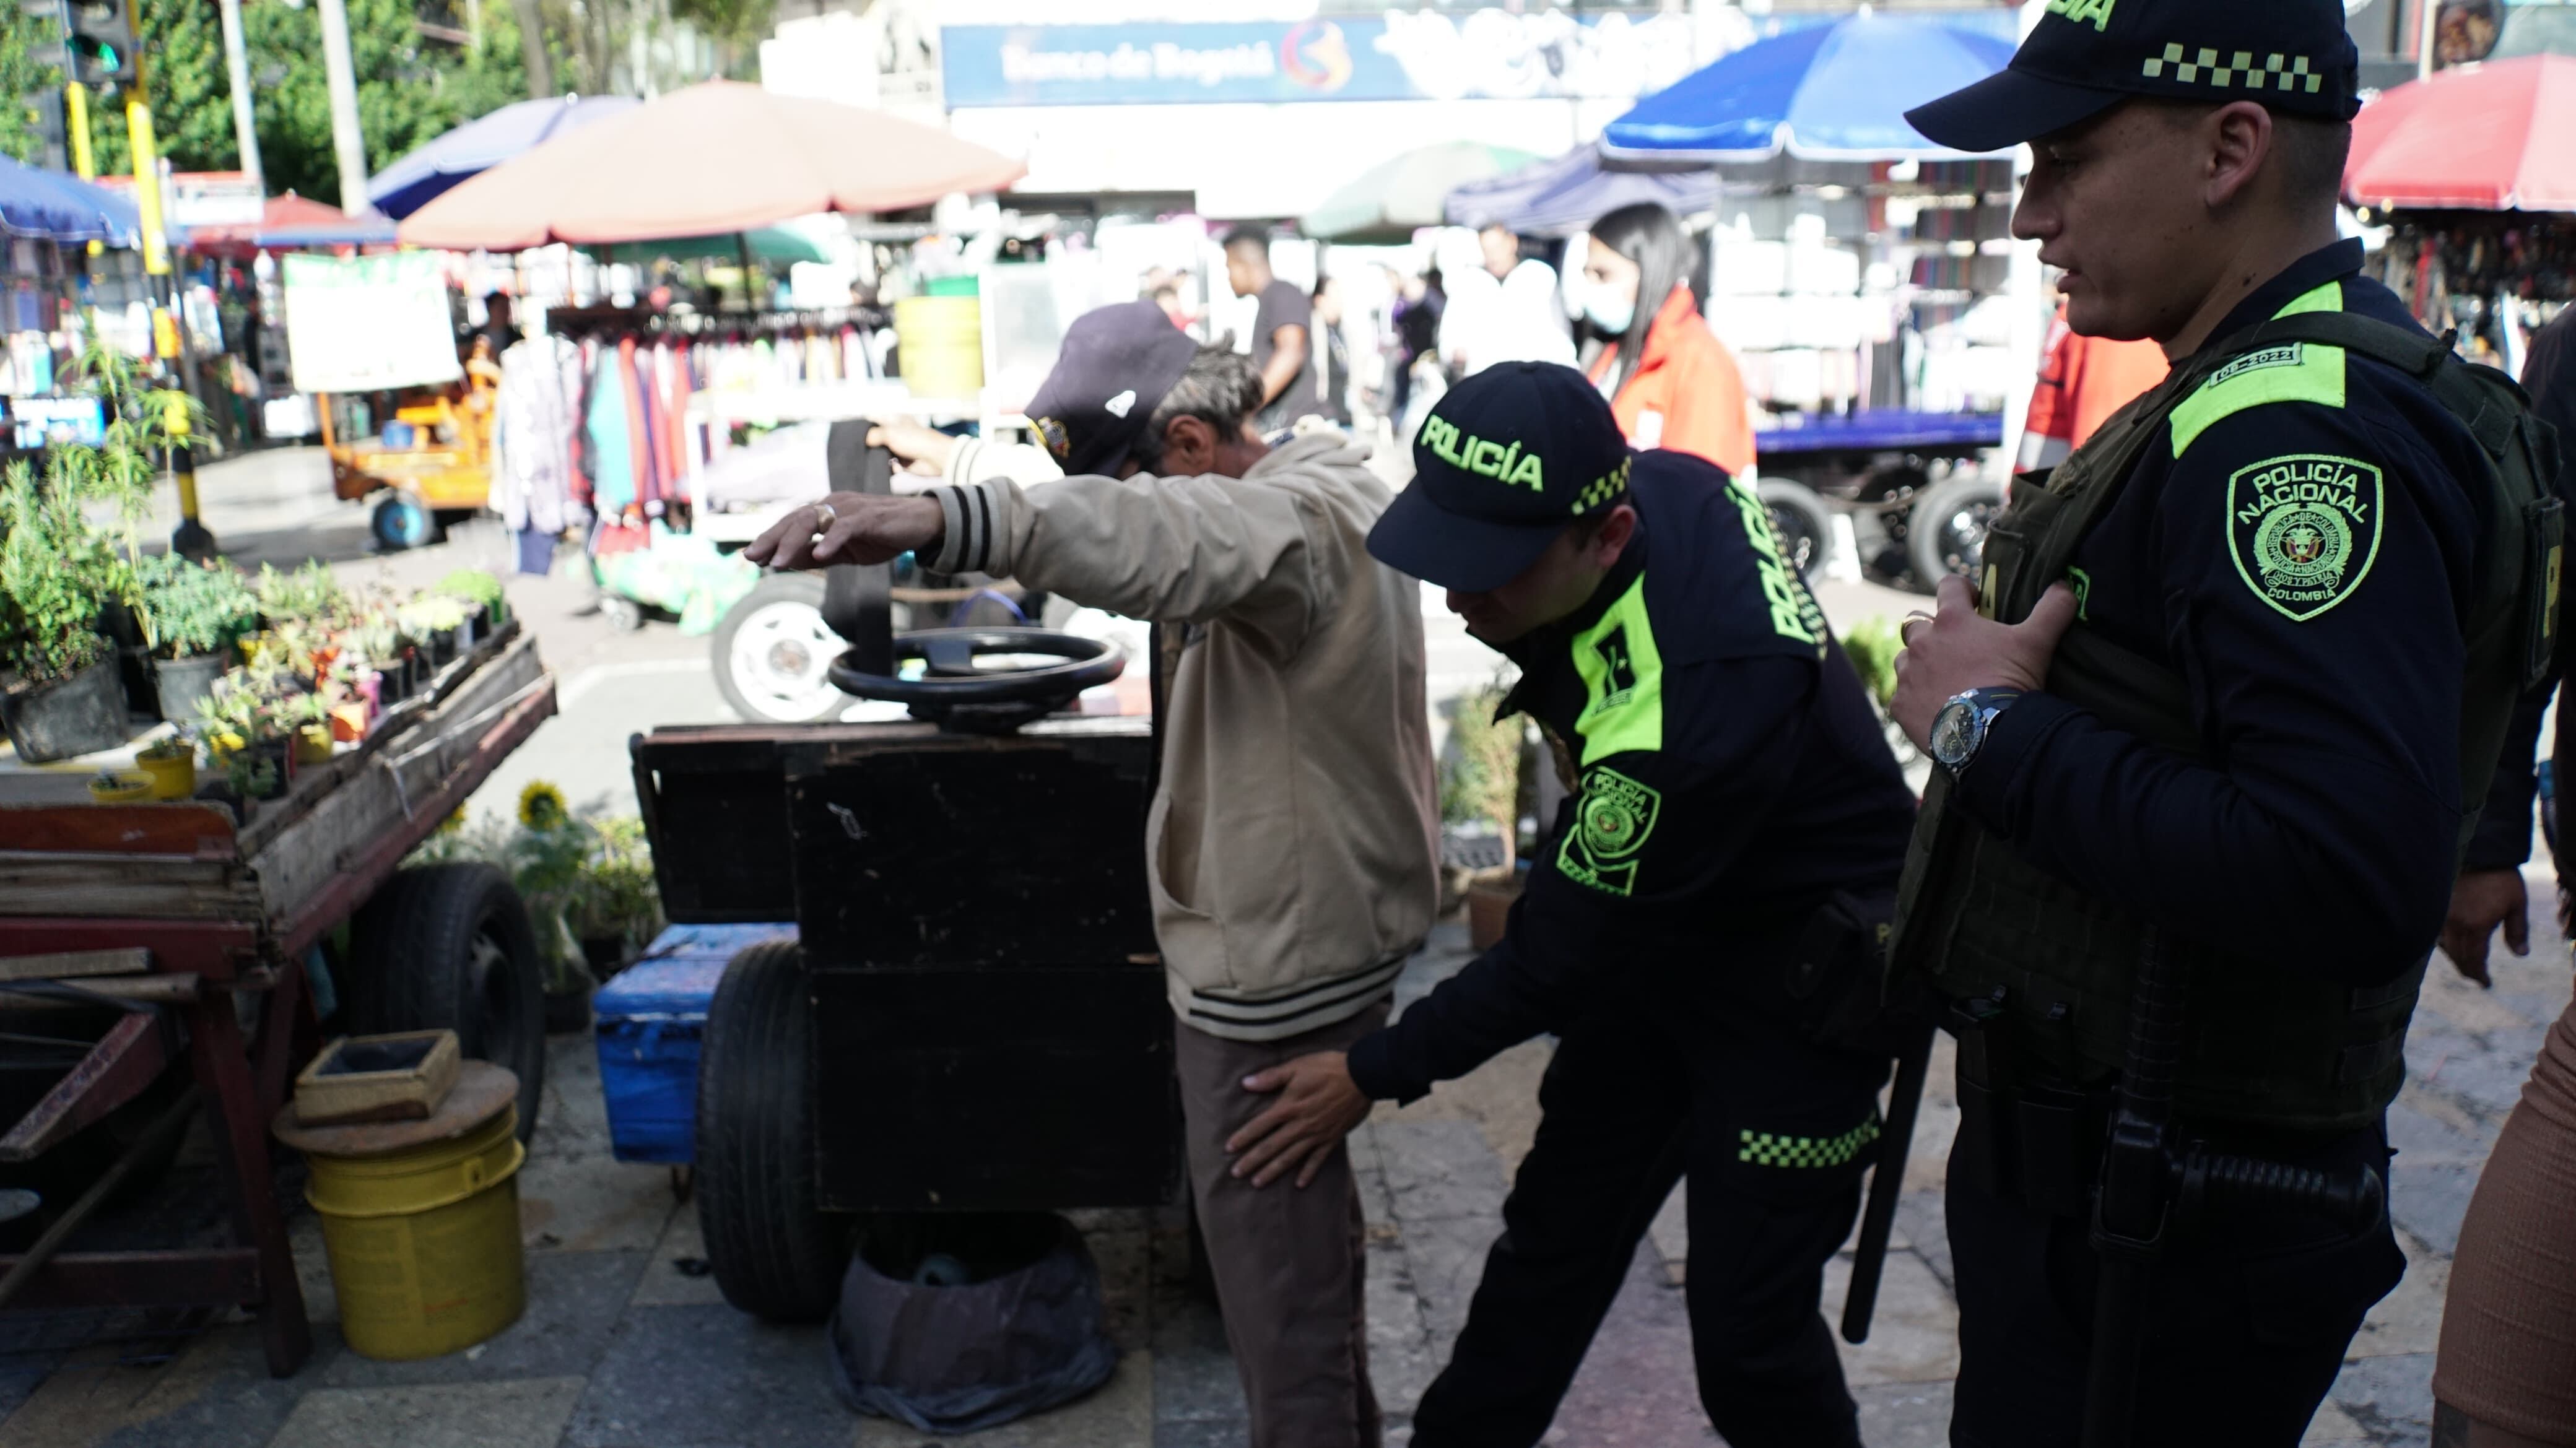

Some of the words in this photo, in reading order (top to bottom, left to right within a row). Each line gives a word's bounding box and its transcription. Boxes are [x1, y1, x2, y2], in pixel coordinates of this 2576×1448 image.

[1421, 414, 1544, 492] POLICÍA
[2253, 463, 2358, 494] POLICÍA
[2237, 483, 2368, 525] NACIONAL
[2267, 587, 2336, 602] COLOMBIA
